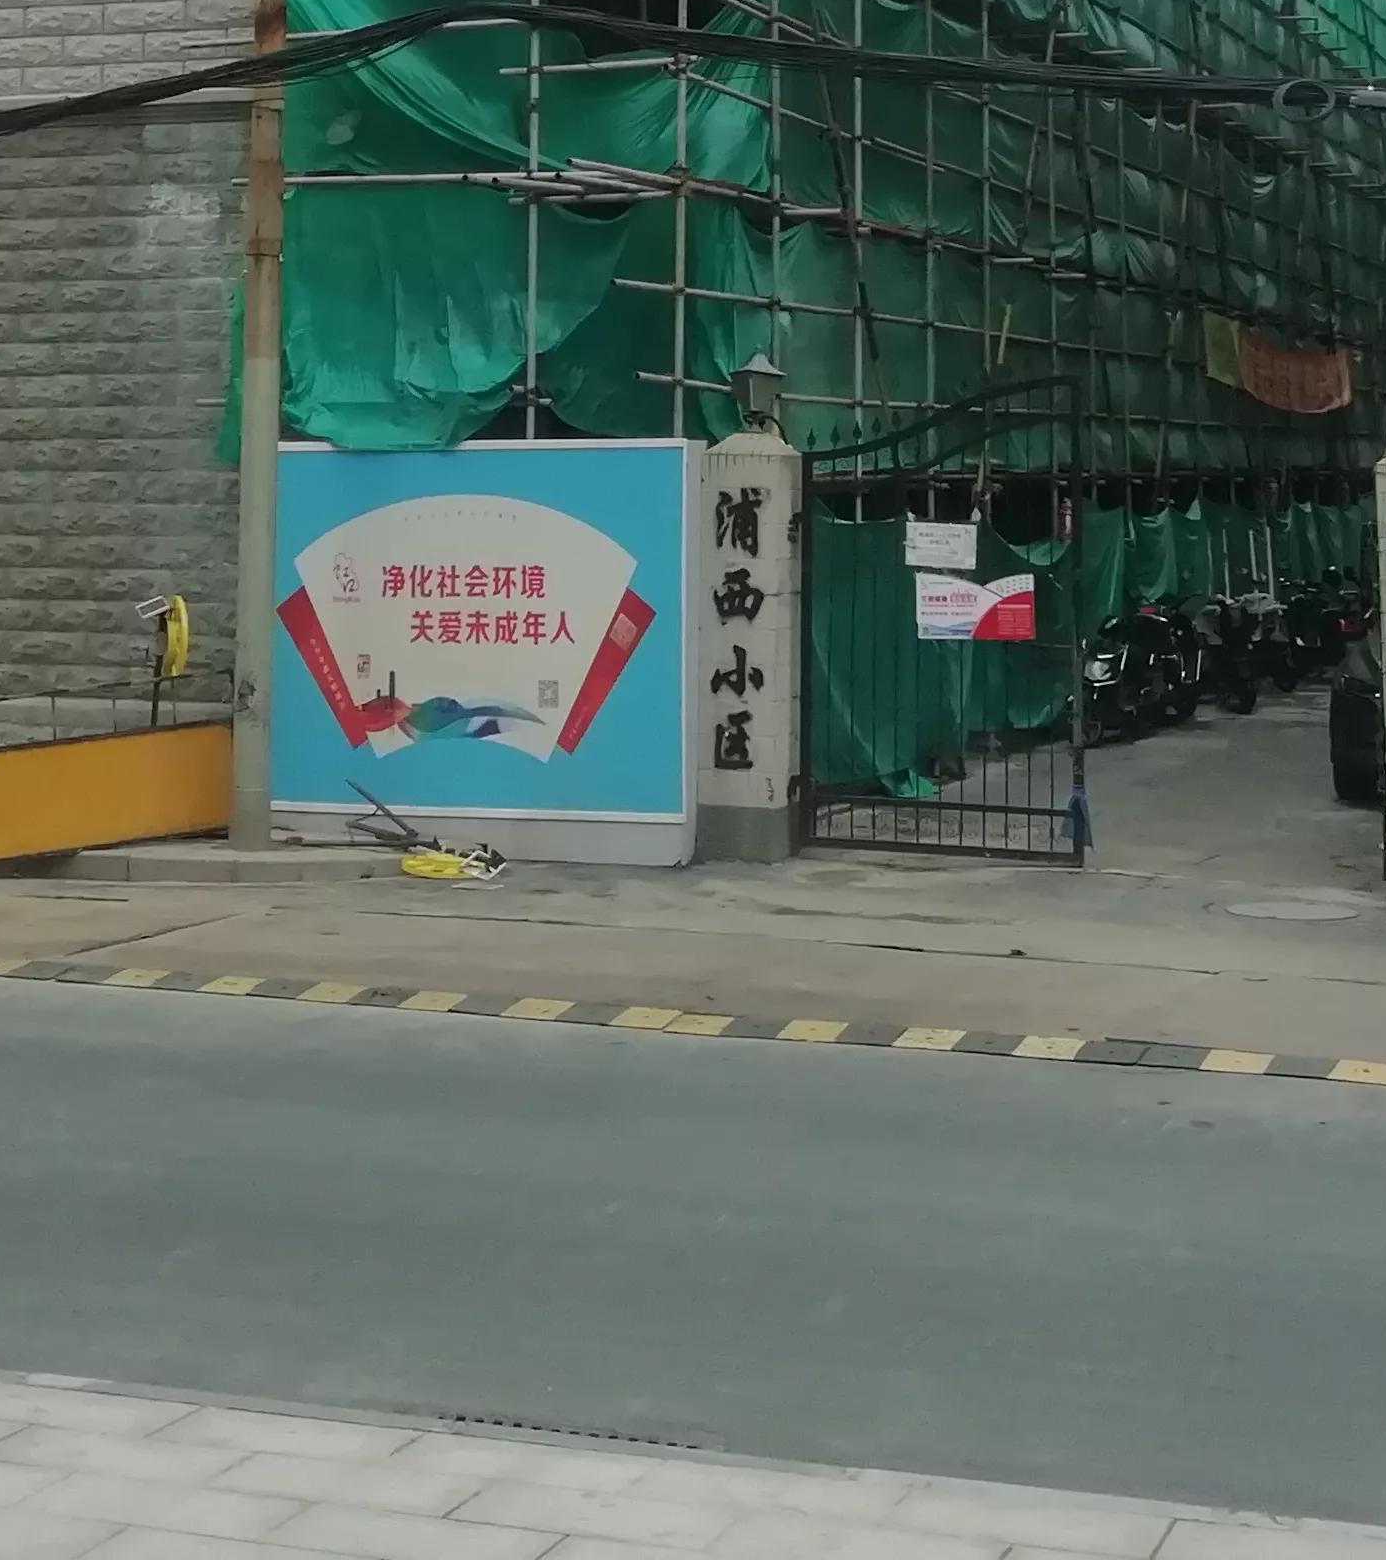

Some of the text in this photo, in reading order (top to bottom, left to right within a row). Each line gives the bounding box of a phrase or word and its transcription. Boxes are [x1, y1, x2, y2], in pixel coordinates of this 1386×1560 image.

[381, 564, 546, 598] 净化社会环境
[410, 610, 575, 645] 关爱未成年人
[710, 487, 765, 771] 浦西小区
